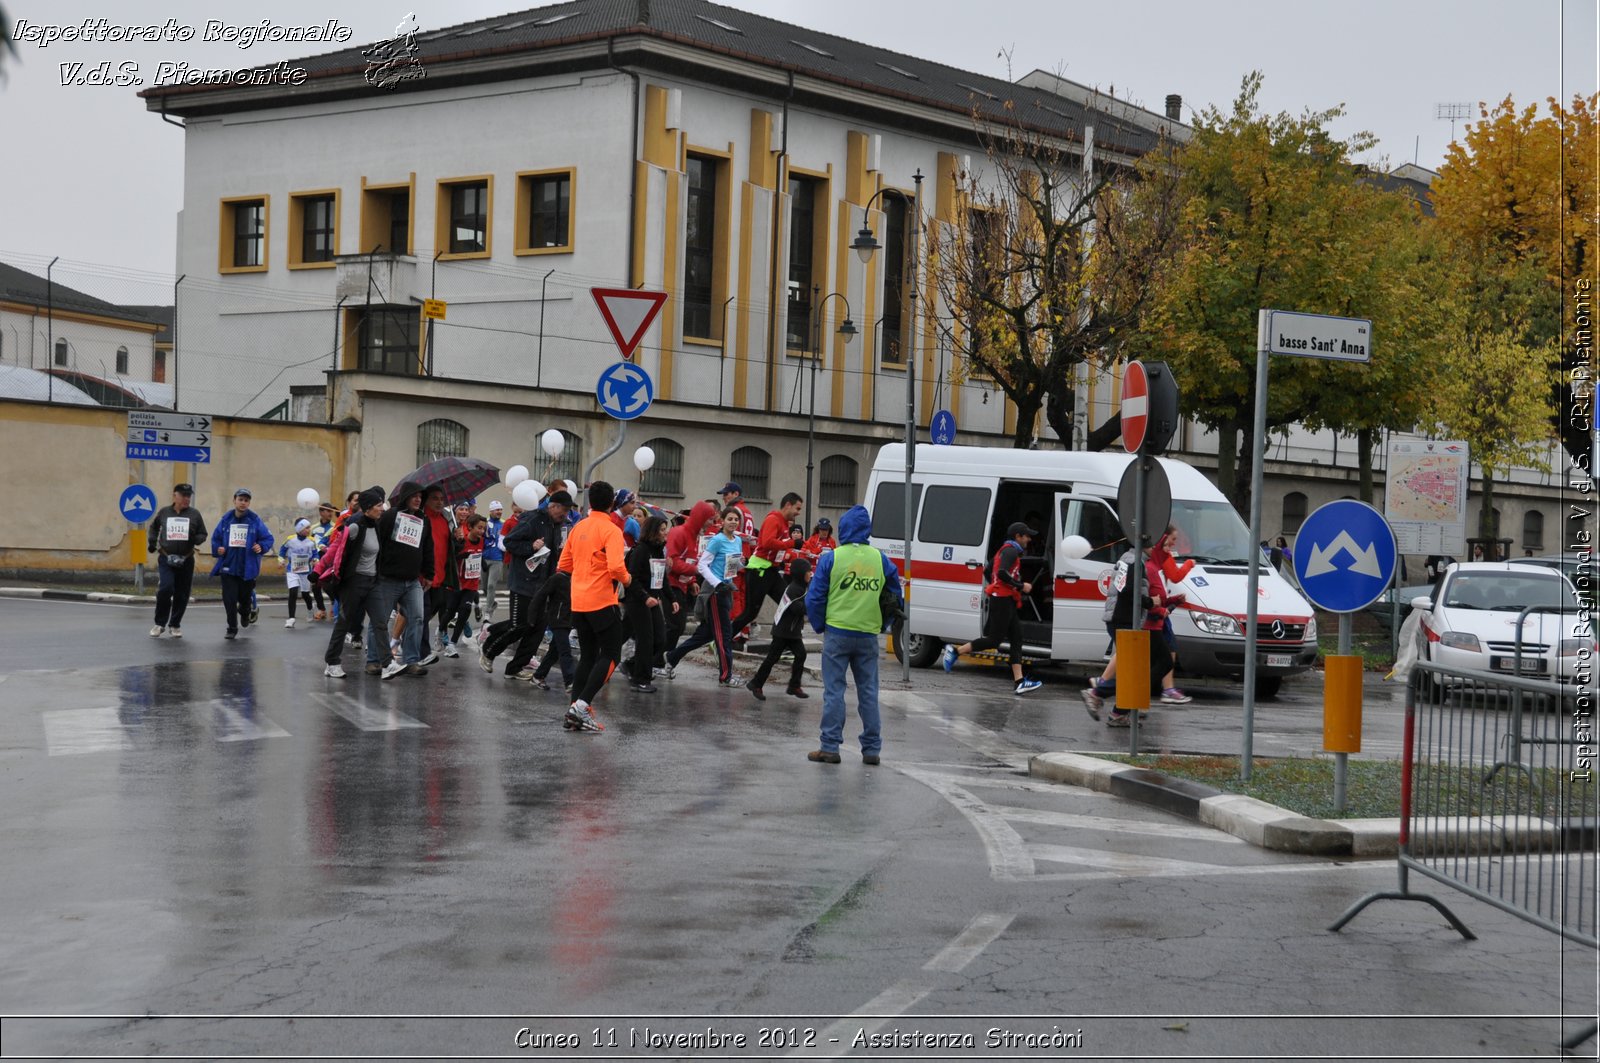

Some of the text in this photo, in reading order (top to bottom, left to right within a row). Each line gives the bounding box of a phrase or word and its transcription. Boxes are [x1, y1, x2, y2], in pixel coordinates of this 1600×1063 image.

[1279, 333, 1365, 355] basse Sant' Anna
[130, 412, 155, 421] polizia
[130, 419, 162, 427] stradale
[128, 447, 169, 457] FRANCIA
[854, 577, 880, 592] asics
